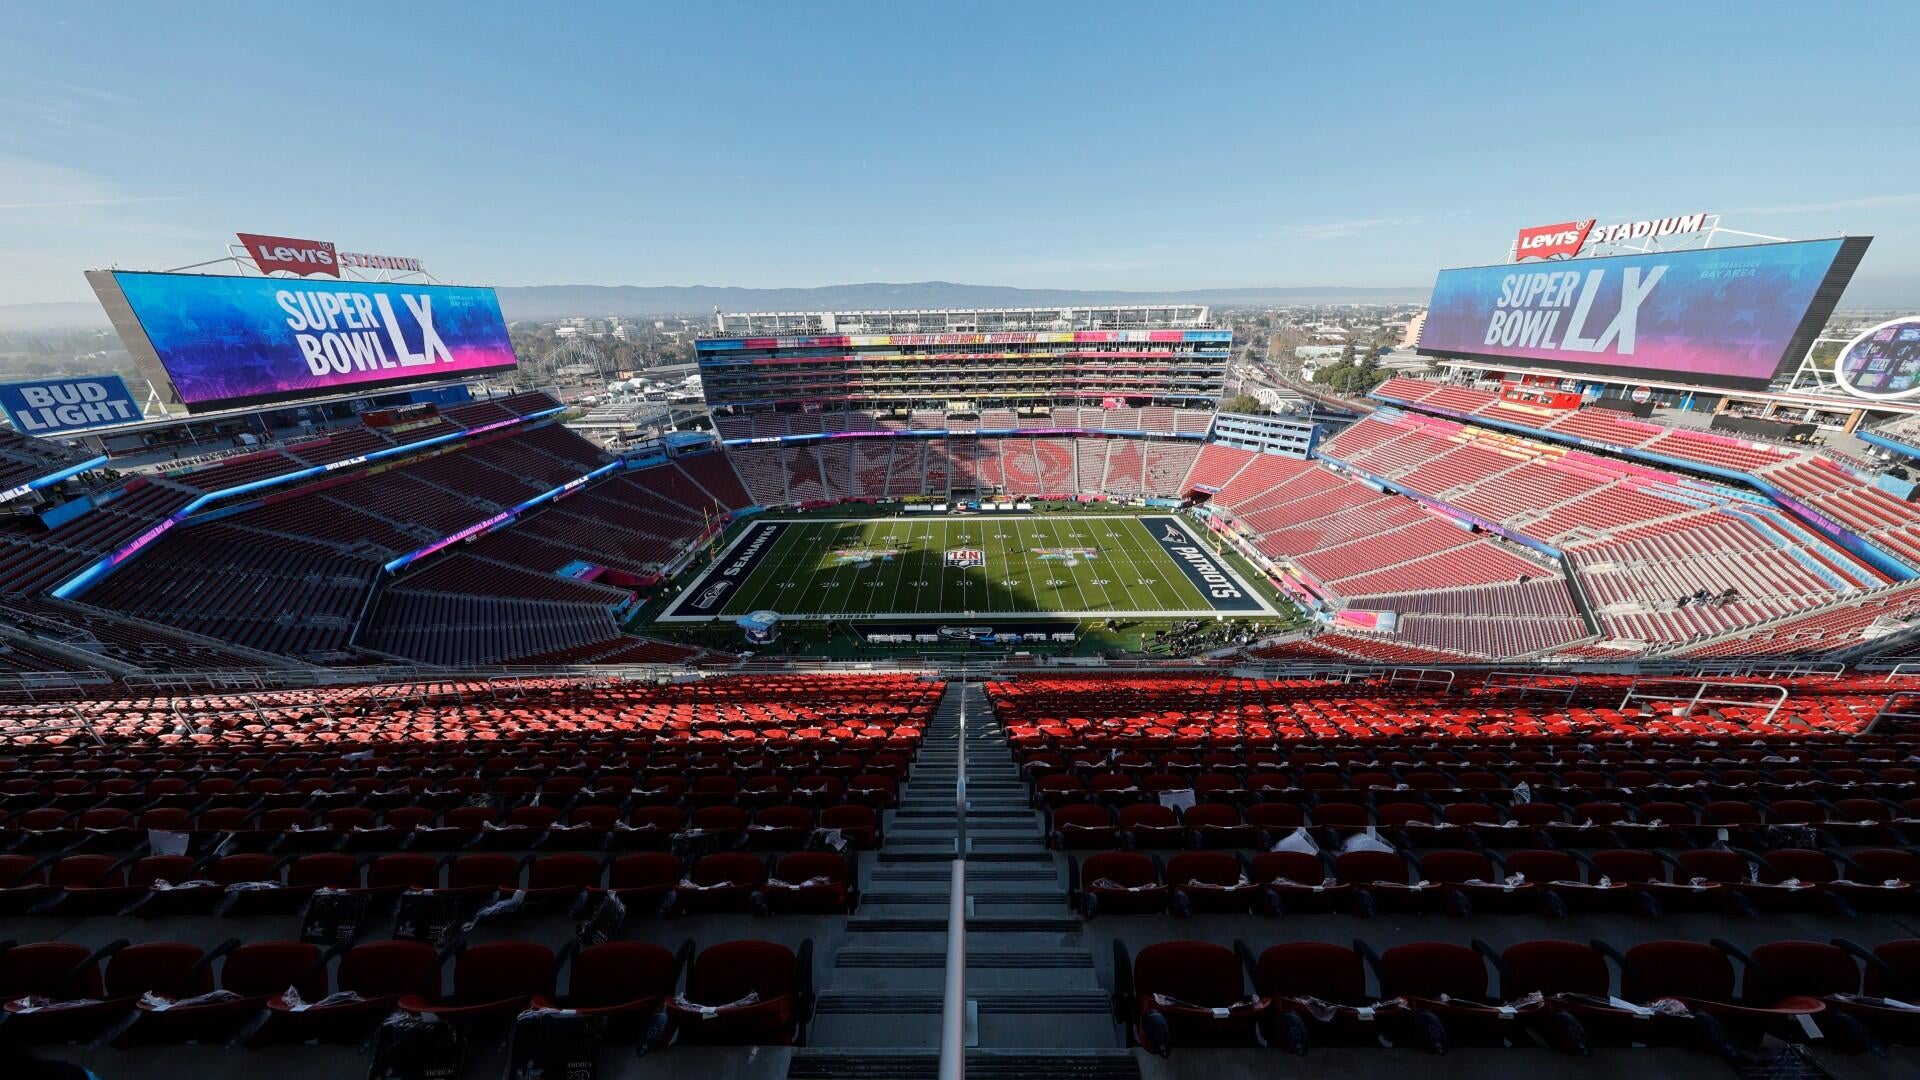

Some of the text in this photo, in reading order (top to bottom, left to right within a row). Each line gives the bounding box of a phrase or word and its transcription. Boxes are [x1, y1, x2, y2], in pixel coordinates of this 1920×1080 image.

[1592, 214, 1705, 243] STADIUM
[339, 252, 424, 272] STADIUM
[1497, 271, 1580, 308] SUPER
[276, 290, 380, 331] SUPER
[1560, 265, 1669, 355] LX
[374, 293, 455, 367] LX
[889, 335, 909, 345] SUPER
[910, 335, 926, 344] BOWL
[939, 335, 959, 344] SUPER
[960, 334, 976, 343] BOWL
[990, 334, 1010, 343] SUPER
[1011, 333, 1028, 343] BOWL
[1484, 310, 1560, 350] BOWL
[295, 331, 397, 376] BOWL
[20, 383, 108, 408] BUD
[16, 400, 131, 430] LIGHT
[723, 525, 777, 576] SEAHAWKS
[952, 551, 979, 560] NFL
[1170, 547, 1241, 598] PATRIOTS
